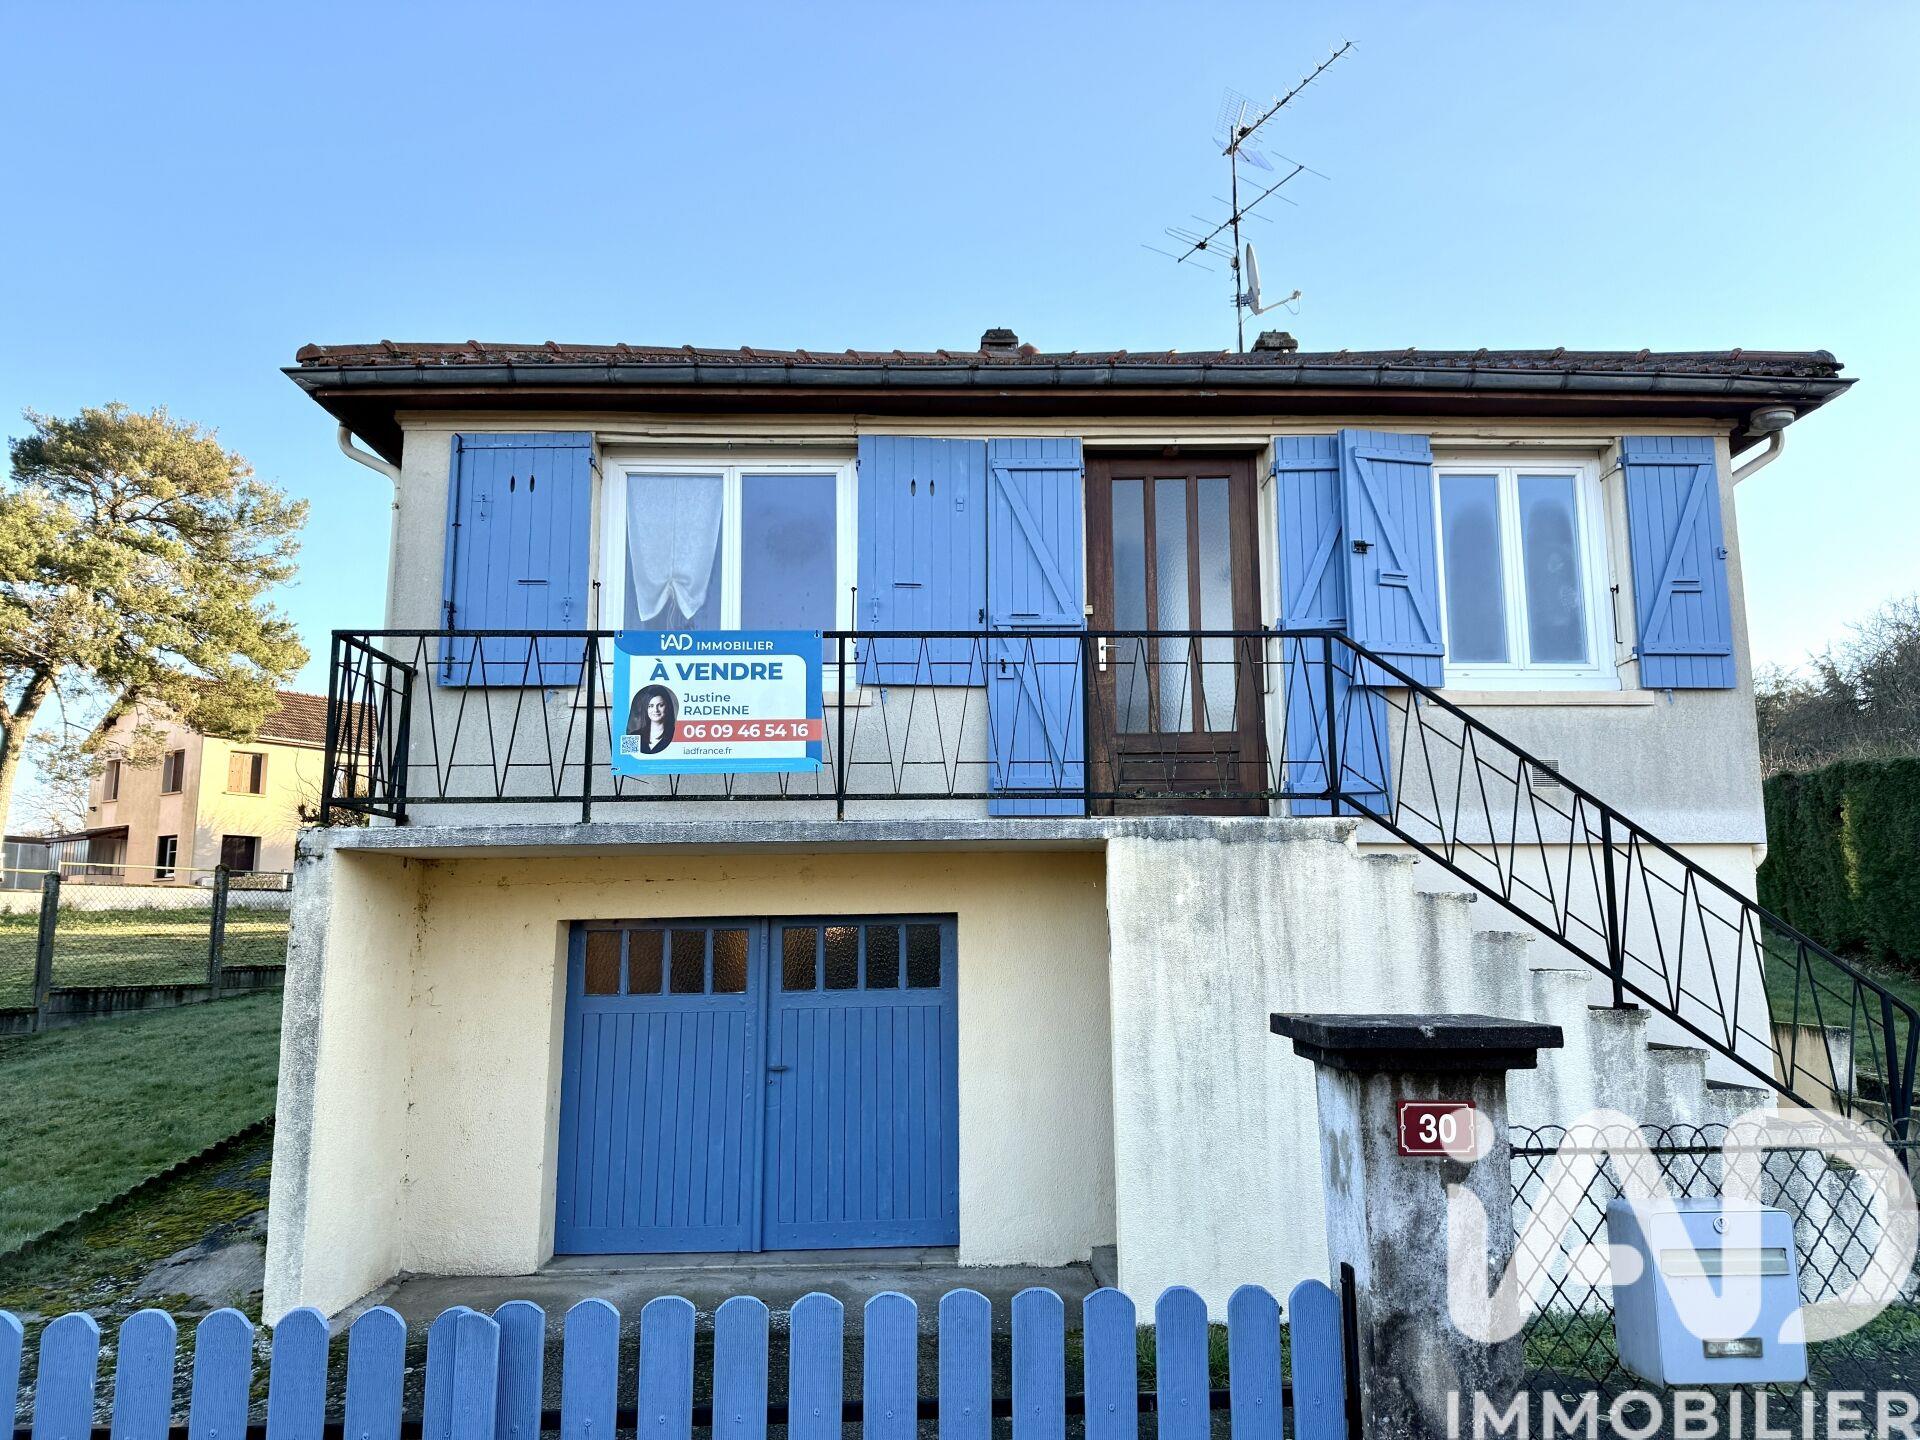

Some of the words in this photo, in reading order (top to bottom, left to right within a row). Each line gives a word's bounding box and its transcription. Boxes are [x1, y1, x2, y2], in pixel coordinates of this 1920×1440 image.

[697, 641, 774, 651] IMMOBILIER
[650, 658, 669, 681] À
[675, 662, 783, 681] VENDRE
[683, 692, 731, 703] Justine
[683, 705, 750, 716] RADENNE
[683, 724, 706, 738] 06
[710, 724, 733, 738] 09
[737, 724, 761, 738] 46
[765, 723, 787, 737] 54
[791, 723, 809, 737] 16
[683, 746, 733, 755] iadfrance.fr
[1419, 1113, 1457, 1144] 30
